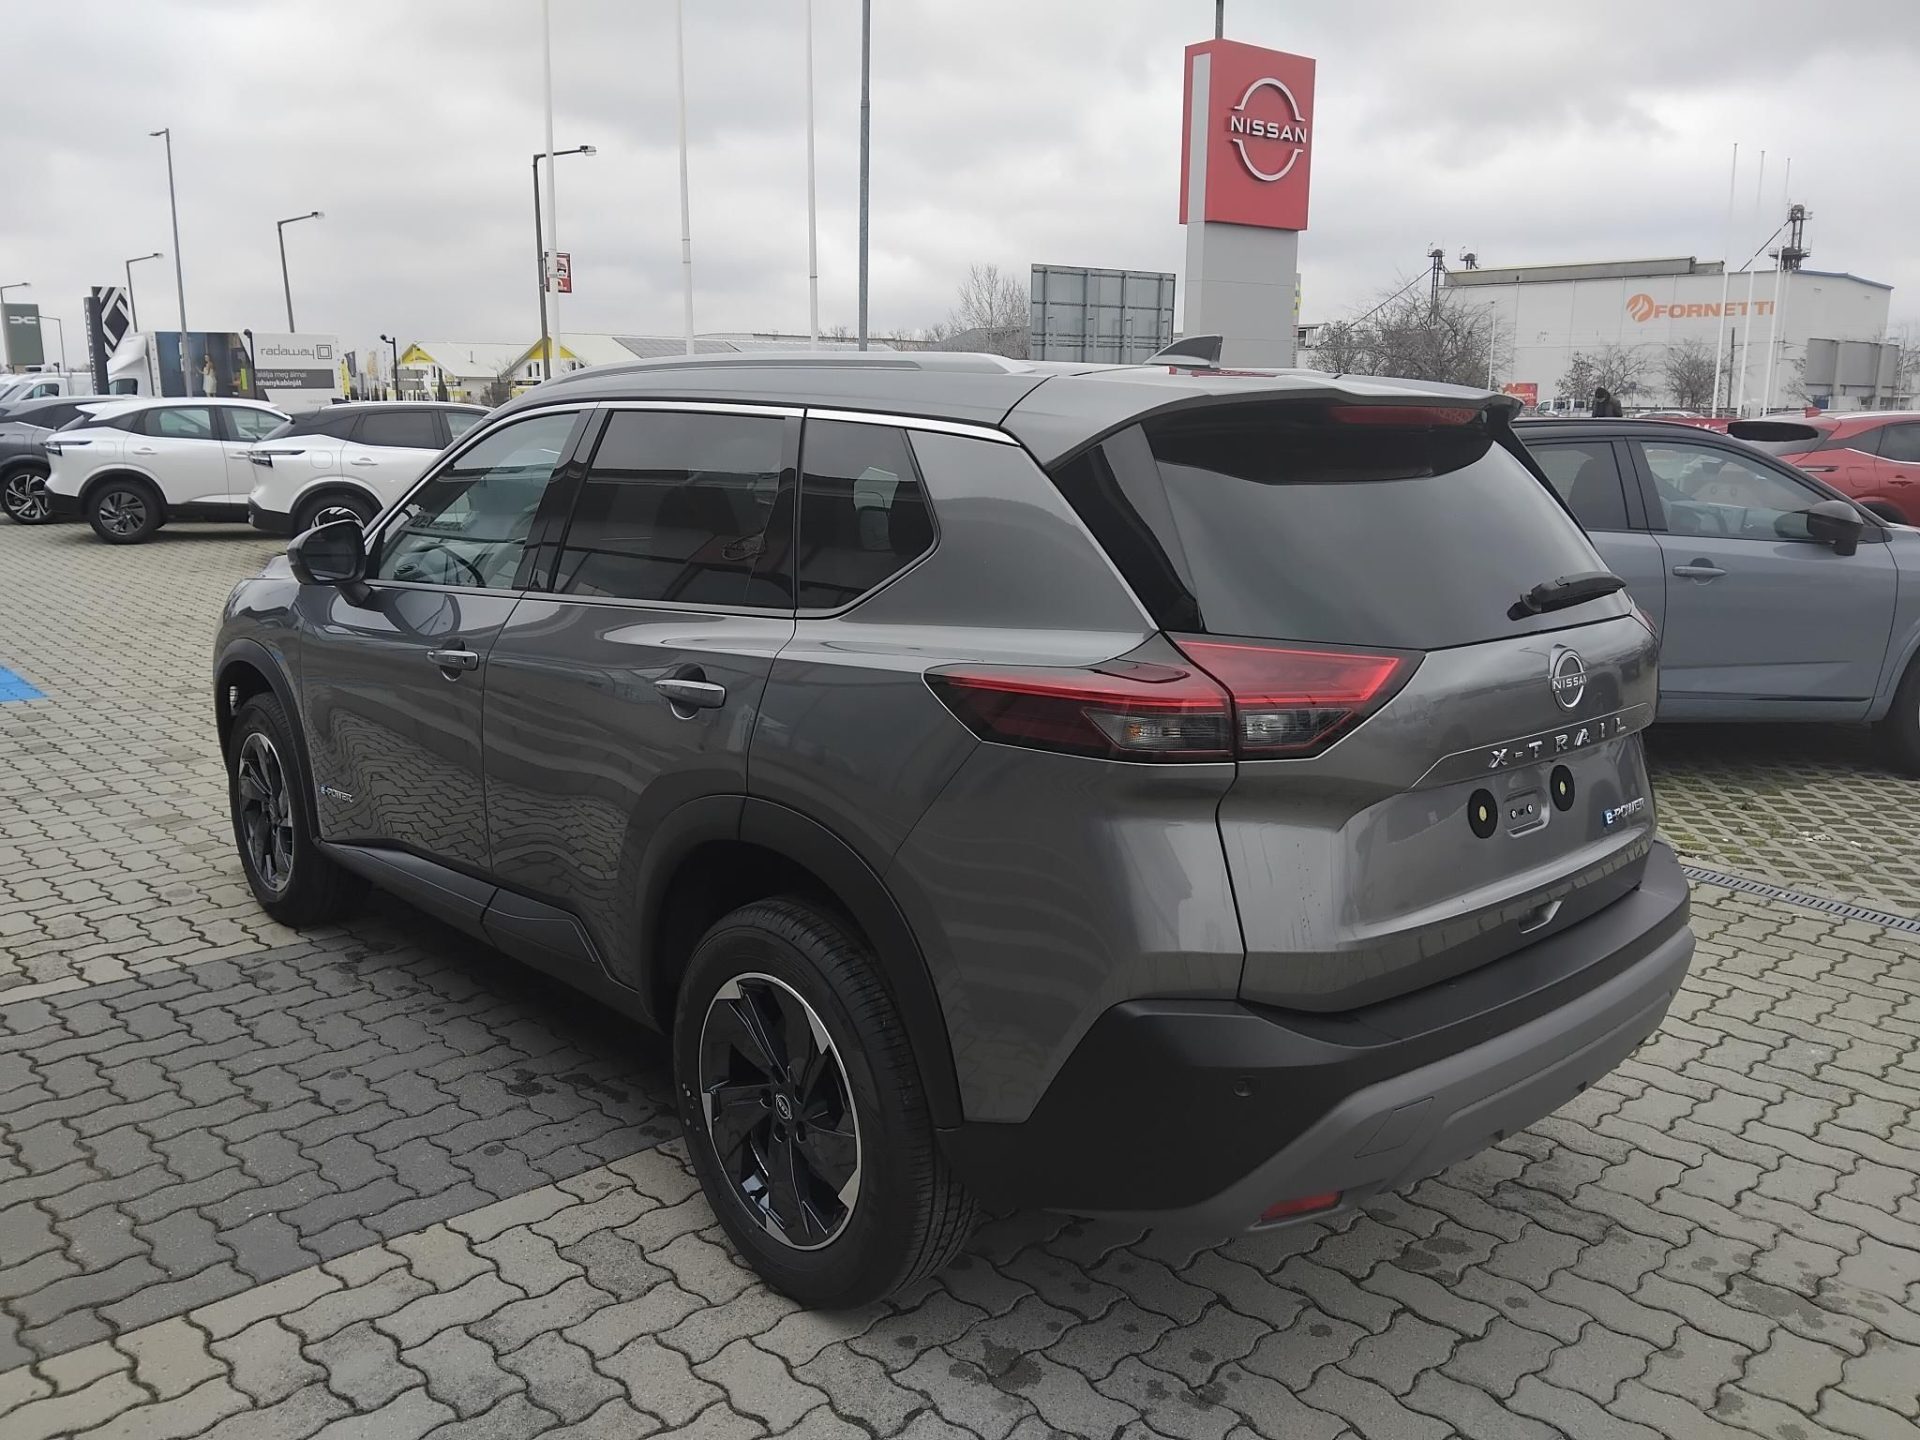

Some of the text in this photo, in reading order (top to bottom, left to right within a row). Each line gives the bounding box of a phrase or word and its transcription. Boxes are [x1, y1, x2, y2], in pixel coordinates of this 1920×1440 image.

[1230, 115, 1307, 144] NISSAN
[1653, 300, 1775, 319] FORNETTI
[260, 344, 315, 360] radaway
[1488, 717, 1627, 769] X-TRAIL
